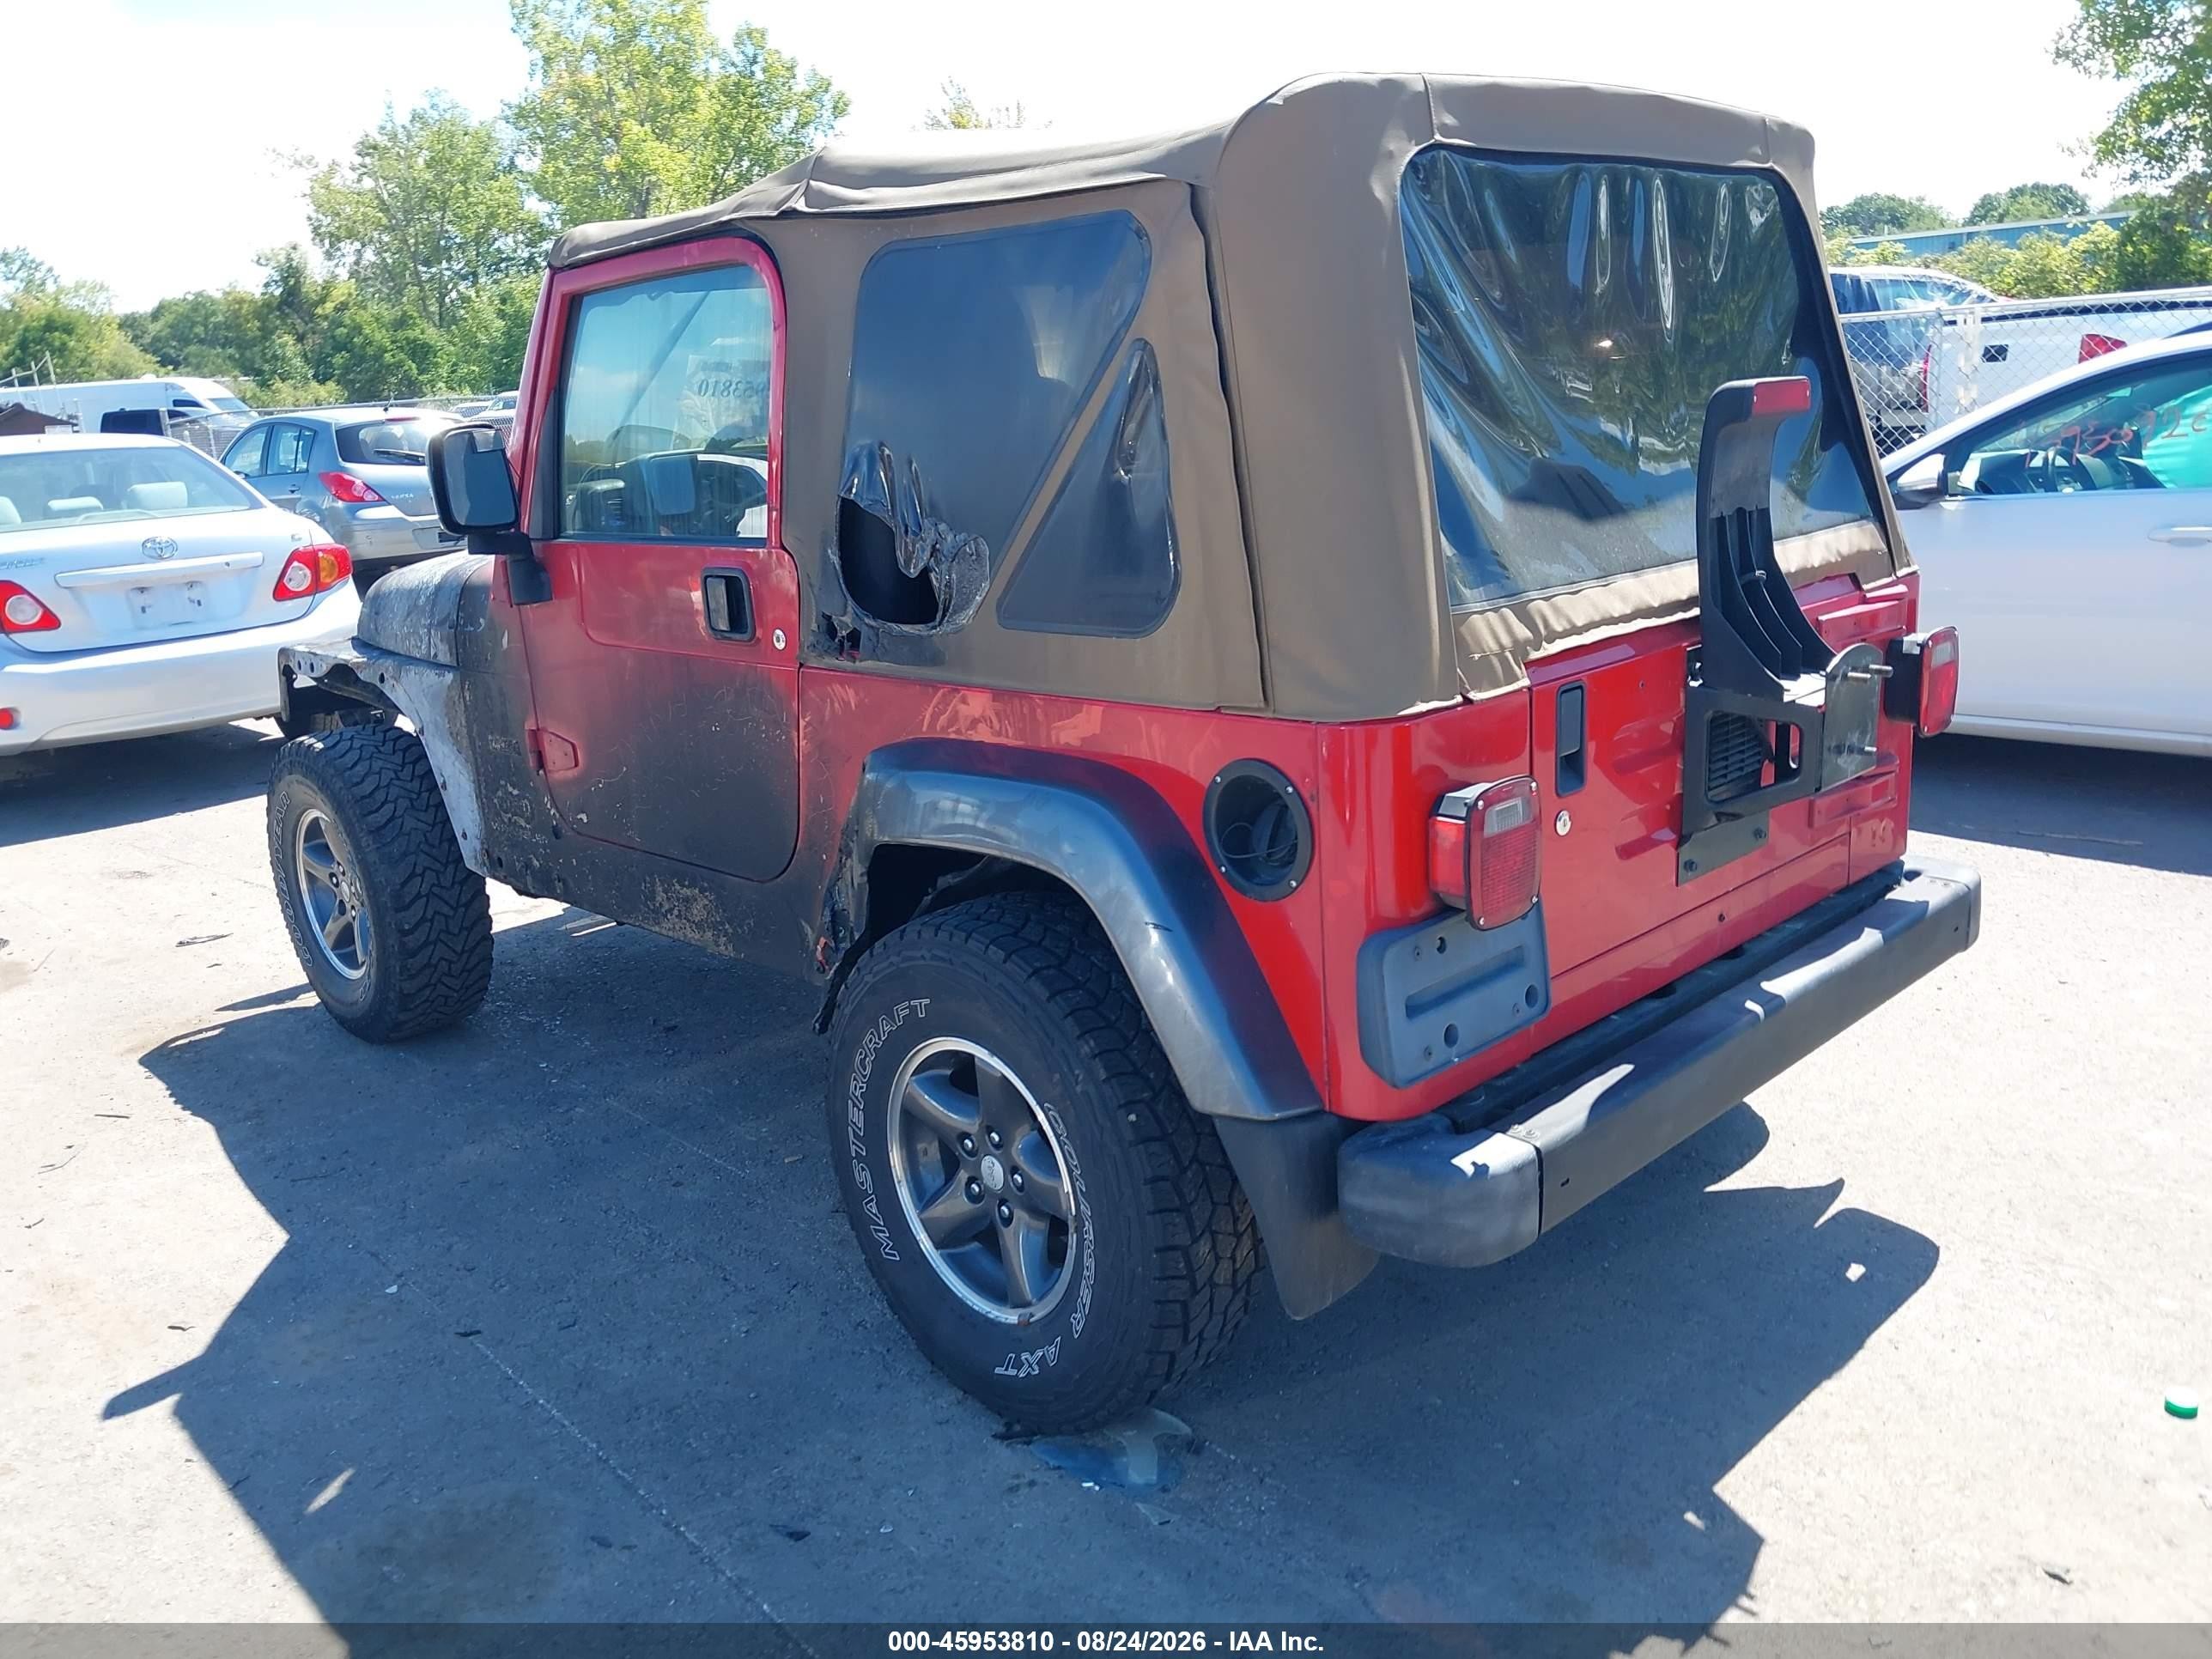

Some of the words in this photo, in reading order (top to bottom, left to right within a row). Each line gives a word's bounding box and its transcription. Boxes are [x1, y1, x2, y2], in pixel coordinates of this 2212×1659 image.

[273, 790, 313, 967] GOODYEAR
[847, 997, 932, 1261] MASTERCRAFT
[1043, 1102, 1096, 1339] COURSER
[994, 1334, 1062, 1379] AXT
